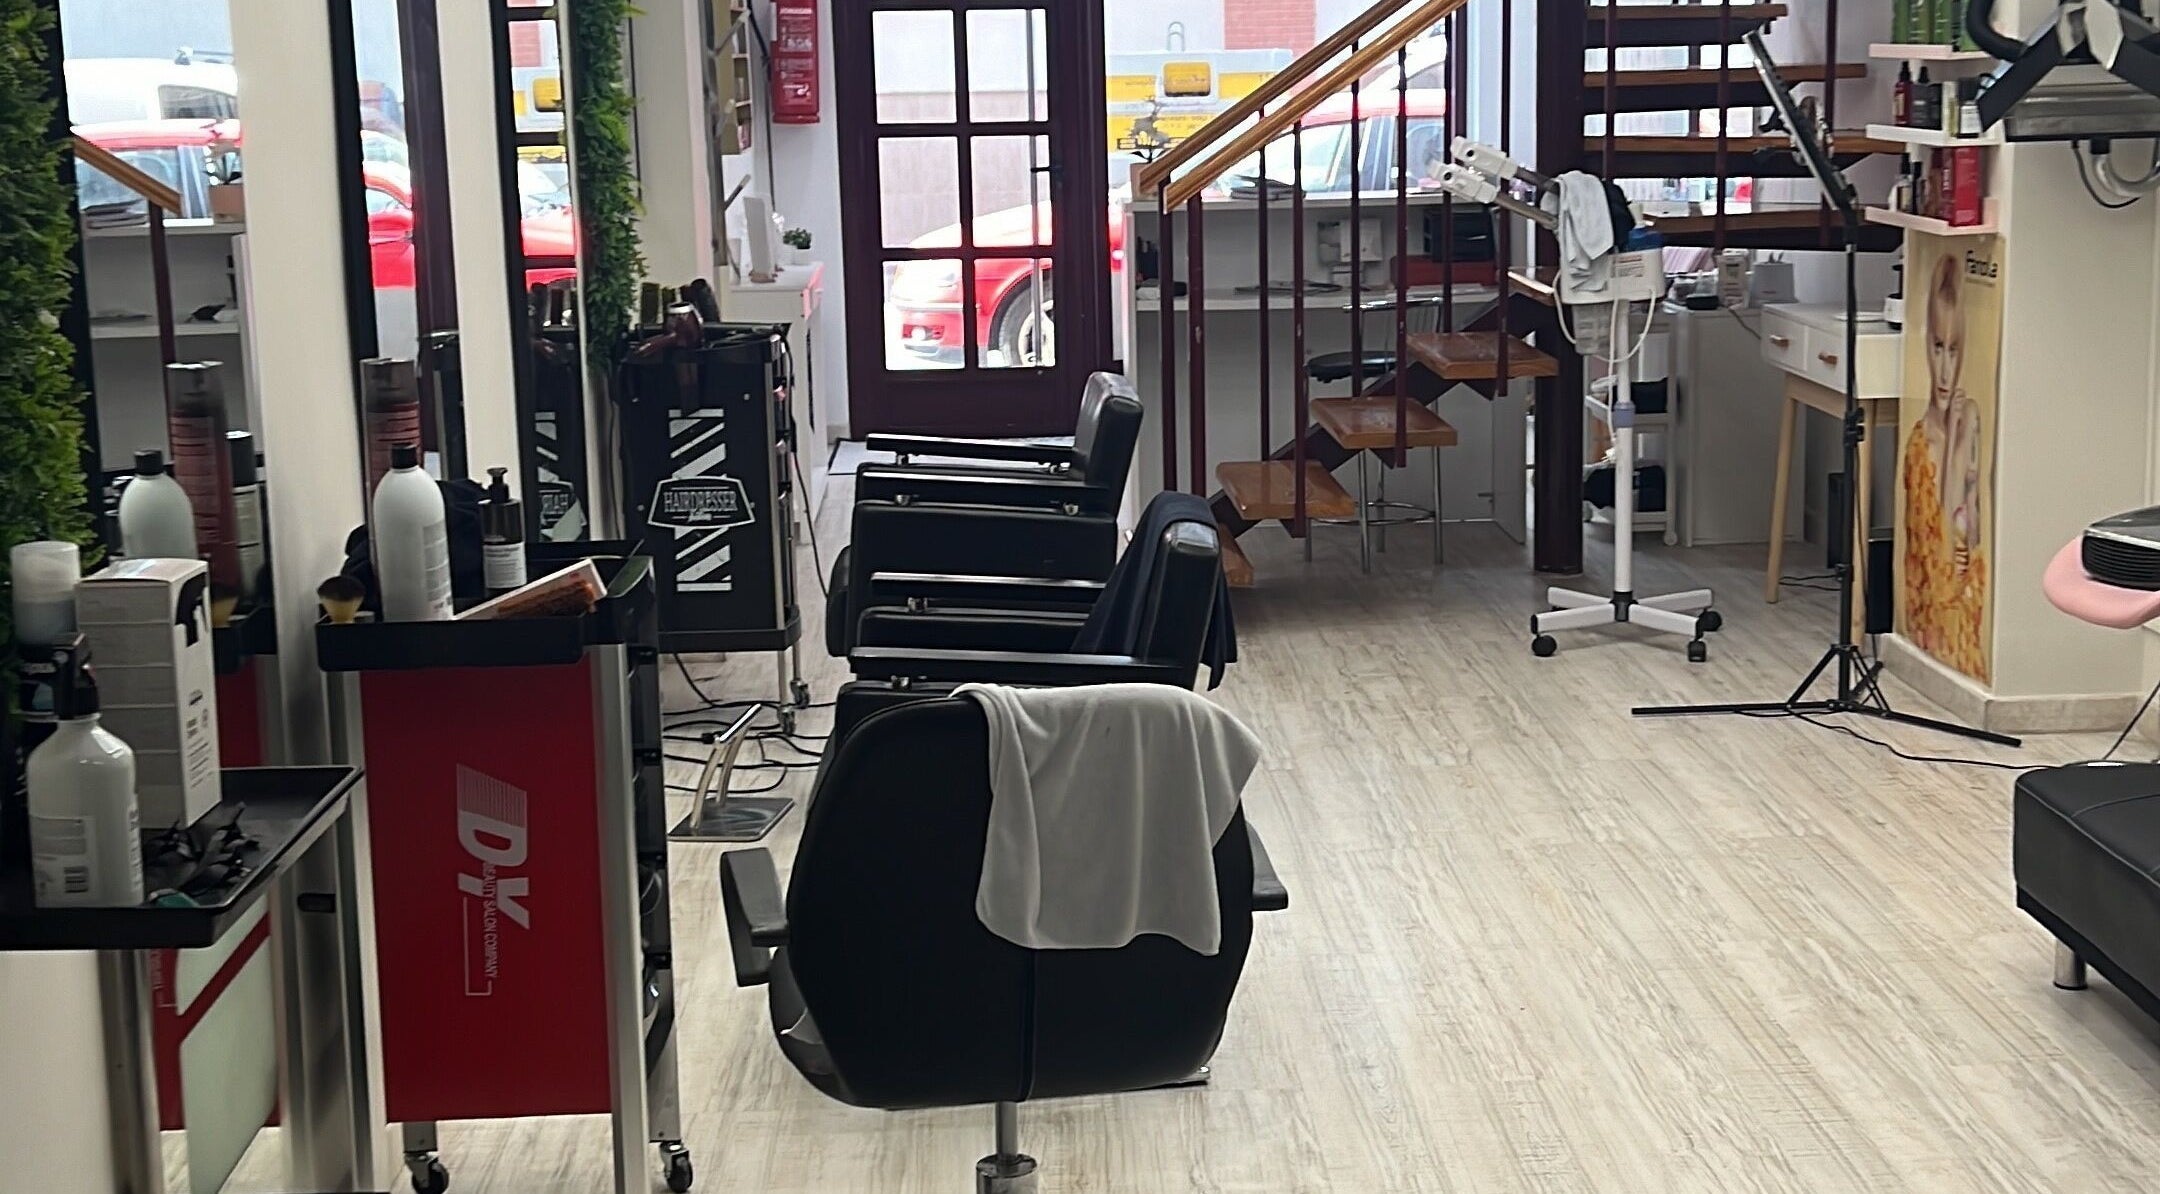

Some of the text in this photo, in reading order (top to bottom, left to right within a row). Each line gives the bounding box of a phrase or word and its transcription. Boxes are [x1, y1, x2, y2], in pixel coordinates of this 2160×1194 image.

[663, 491, 738, 512] HAIRDRESSER
[457, 808, 530, 930] DY
[483, 900, 497, 932] SALON
[483, 933, 498, 978] COMPANY
